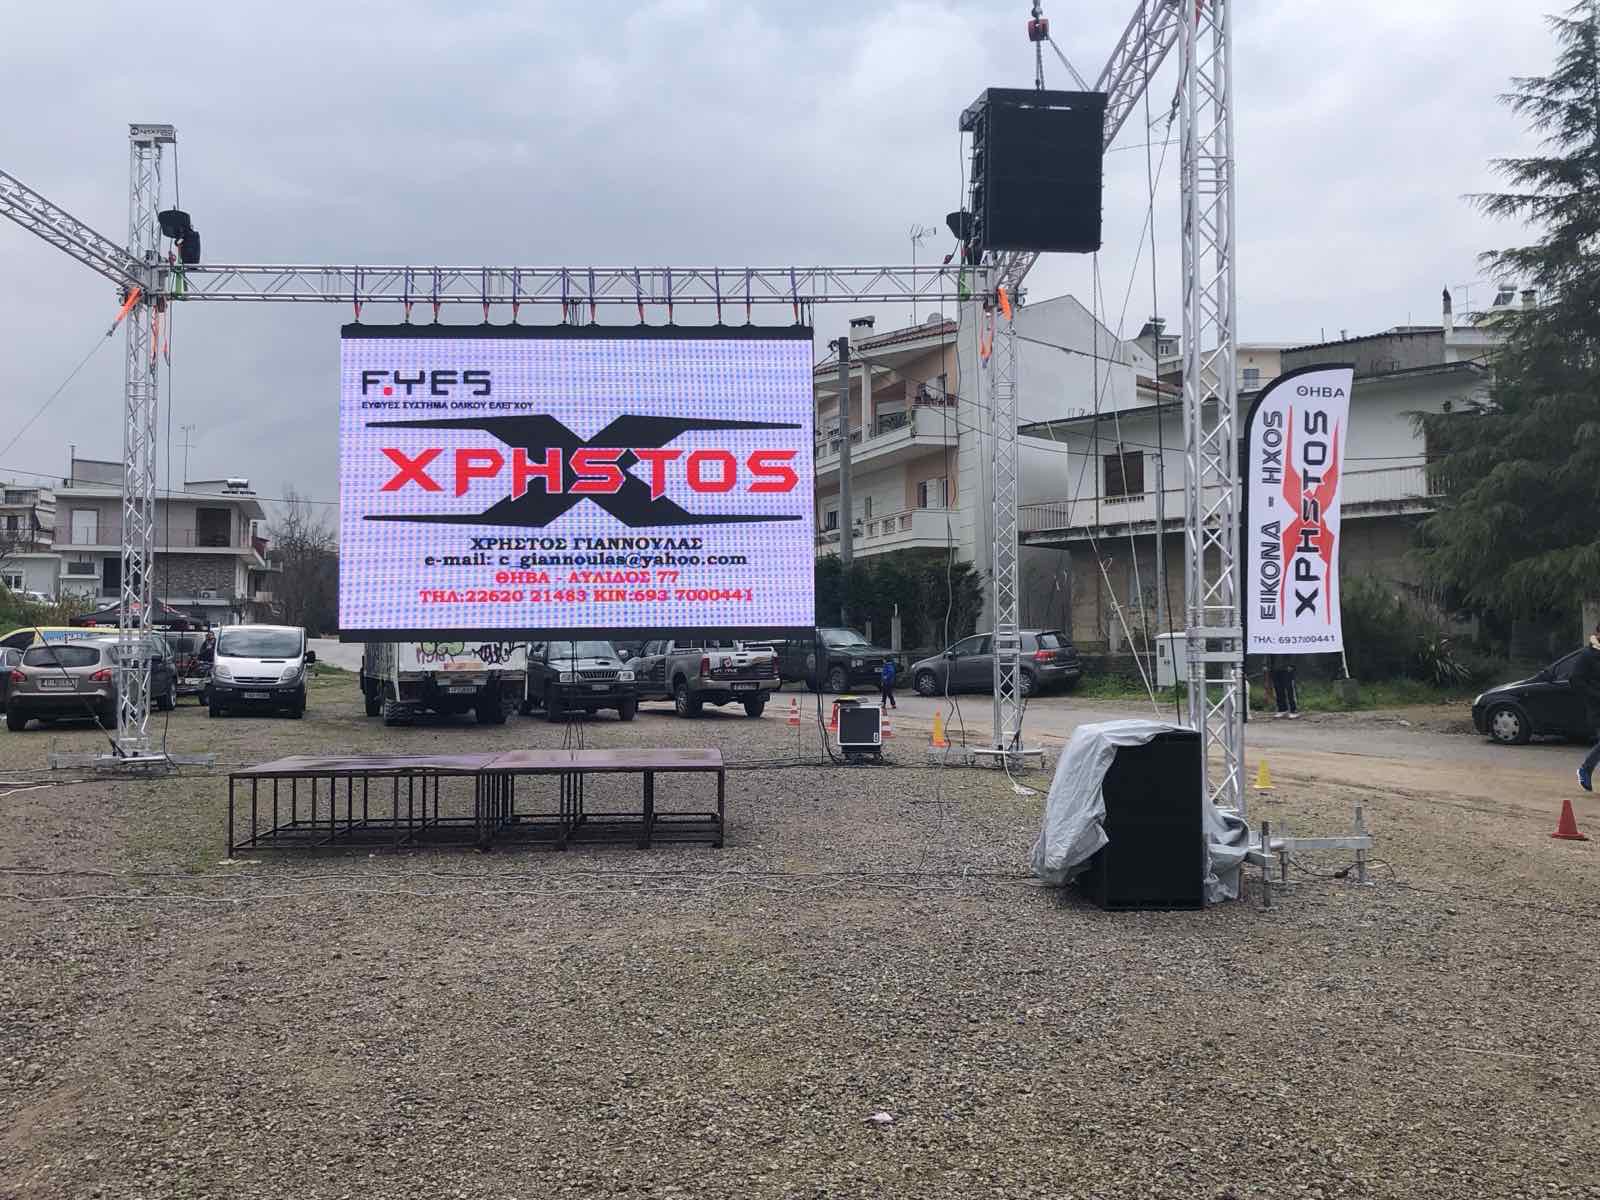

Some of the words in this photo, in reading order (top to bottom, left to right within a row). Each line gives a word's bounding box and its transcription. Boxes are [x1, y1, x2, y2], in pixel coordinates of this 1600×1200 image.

[361, 401, 400, 409] ΕΥΦΥΕΣ
[402, 401, 449, 409] ΣΥΣΤΗΜΑ
[470, 537, 568, 550] ΧΡΗΣΤΟΣ
[574, 537, 704, 550] ΓΙΑΝΝΟΥΛΑΣ
[424, 553, 491, 566] e-mail:
[499, 553, 748, 569] c_giannoulas@yahoo.com
[495, 571, 551, 584] ΘΗΒΑ
[568, 571, 651, 584] ΑΥΛΙΔΟΣ
[656, 571, 680, 583] 77
[674, 588, 753, 601] 7000441
